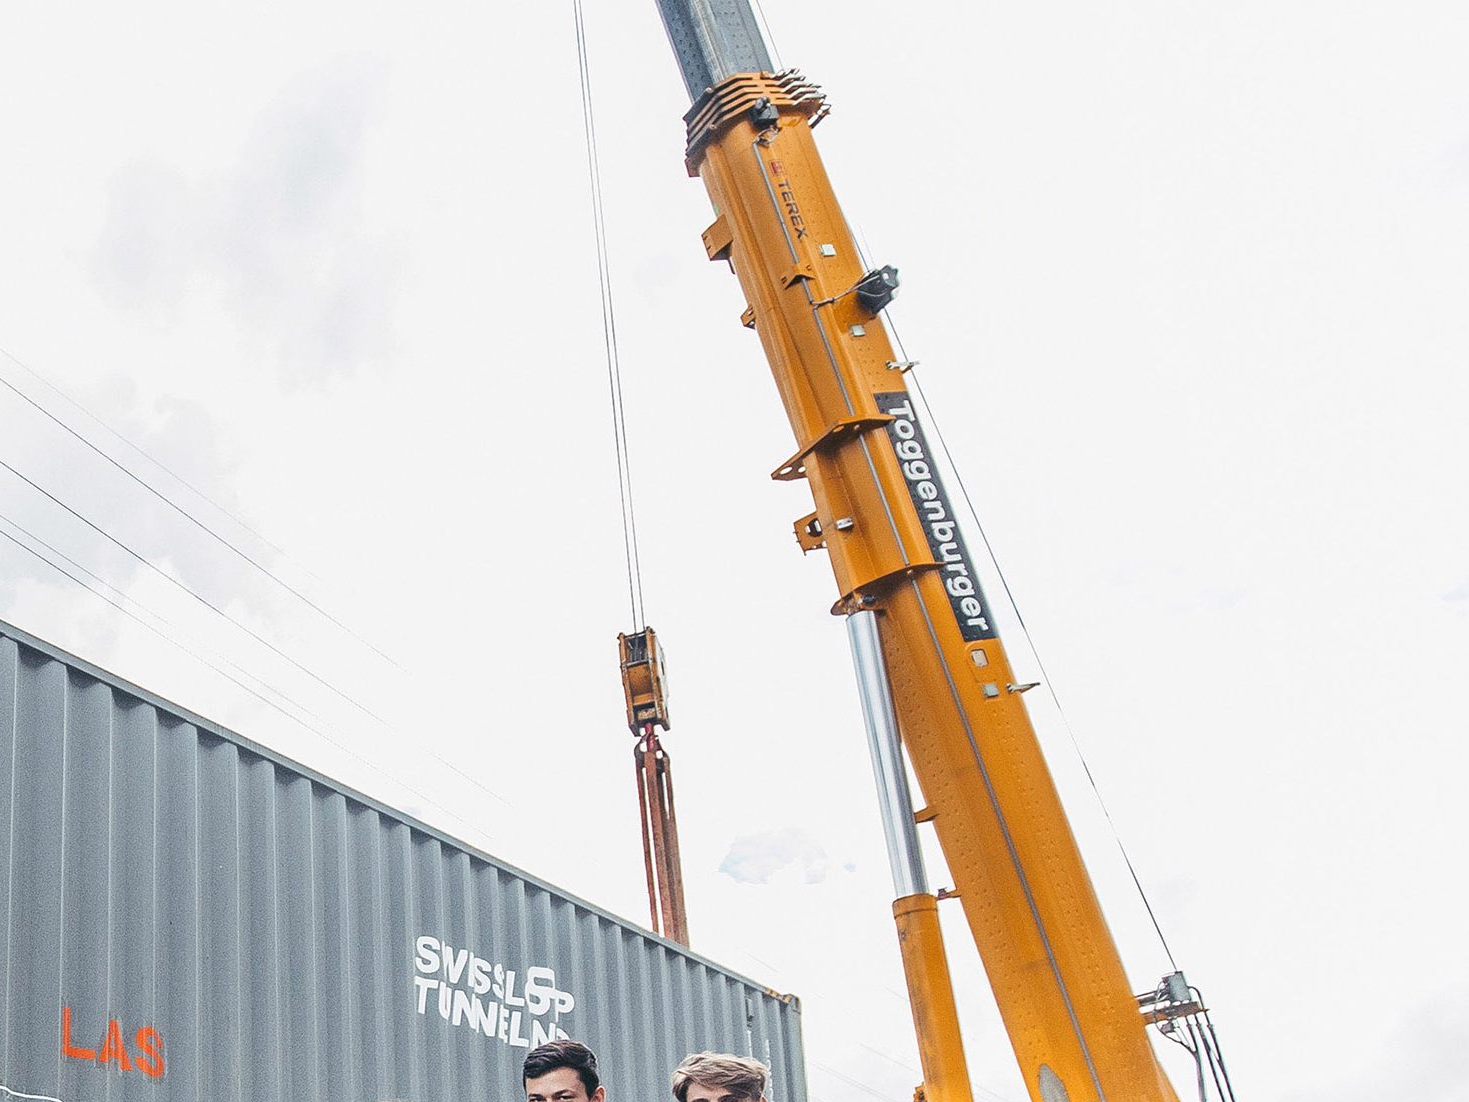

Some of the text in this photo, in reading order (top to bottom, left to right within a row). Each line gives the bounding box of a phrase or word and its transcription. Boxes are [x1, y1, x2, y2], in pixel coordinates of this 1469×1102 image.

[778, 178, 809, 240] TEREX
[887, 400, 989, 631] Toggenburger
[62, 1007, 165, 1079] LAS
